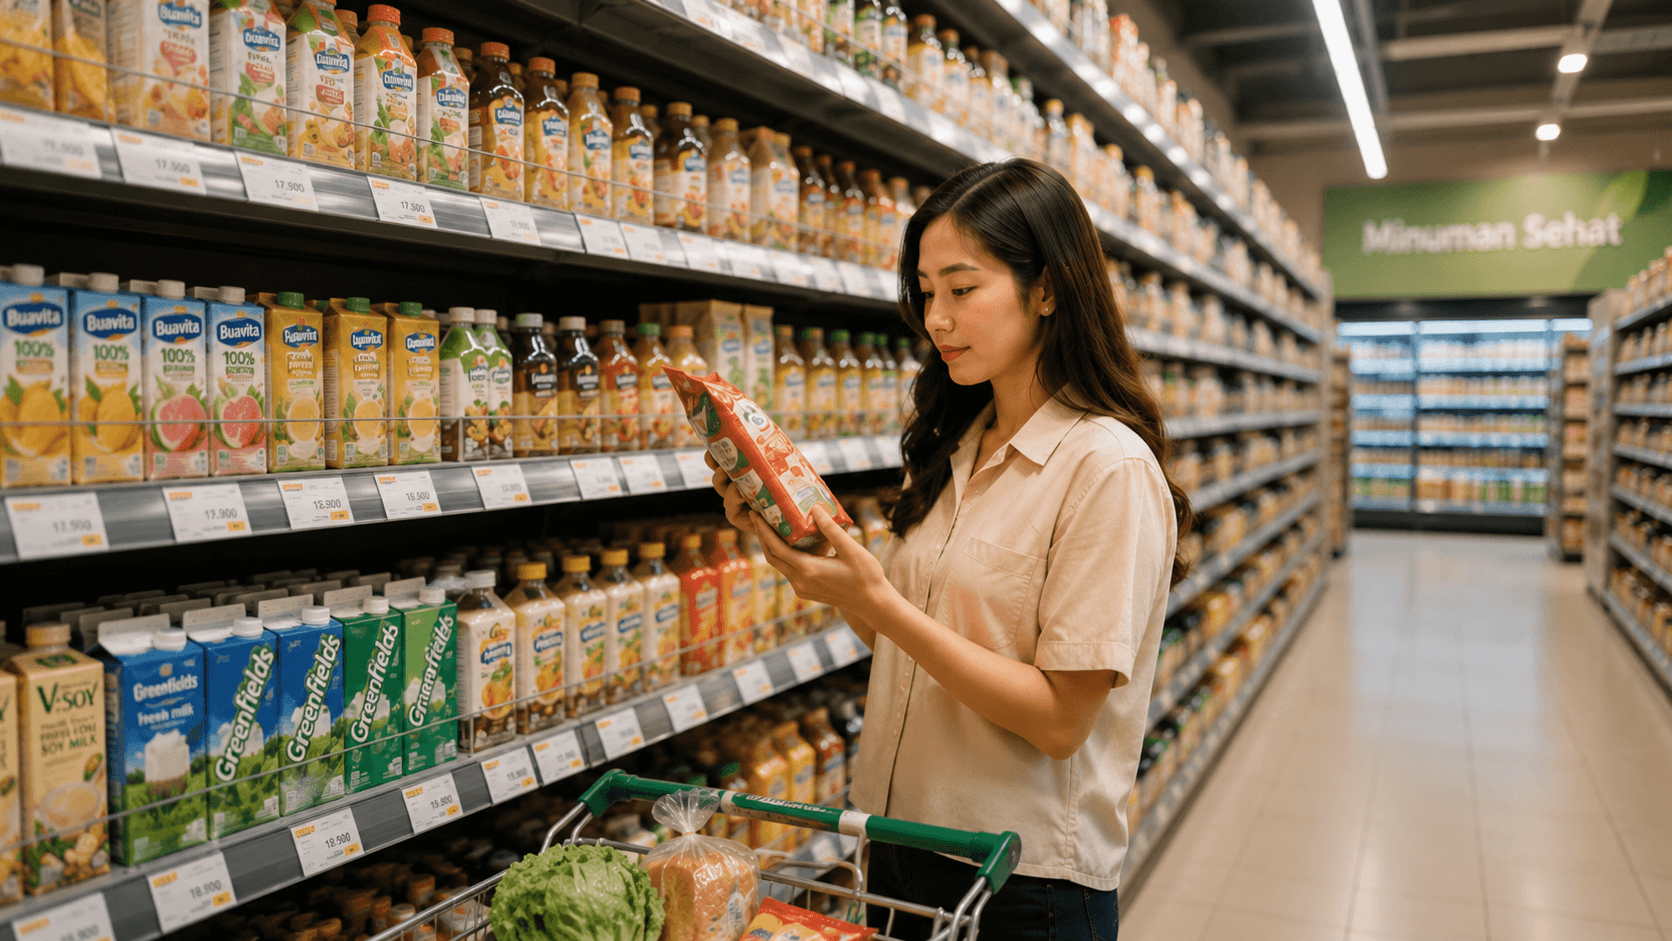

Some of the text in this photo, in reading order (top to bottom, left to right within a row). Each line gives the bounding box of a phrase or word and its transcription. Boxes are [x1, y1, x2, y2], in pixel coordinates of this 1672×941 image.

[1363, 212, 1623, 255] Minuman Sehat
[7, 308, 61, 327] Buavita
[87, 314, 135, 332] Buavita
[156, 319, 200, 336] Buavita
[220, 323, 260, 339] Buavita
[15, 340, 54, 358] 100%
[93, 344, 129, 360] 100%
[160, 348, 195, 363] 100%
[223, 351, 255, 366] 100%
[133, 673, 198, 702] Greenfields
[351, 624, 399, 743] Greenfields
[287, 634, 341, 762] Greenfields
[171, 703, 194, 720] milk
[215, 647, 275, 782] Greenfields
[69, 735, 97, 751] MILK
